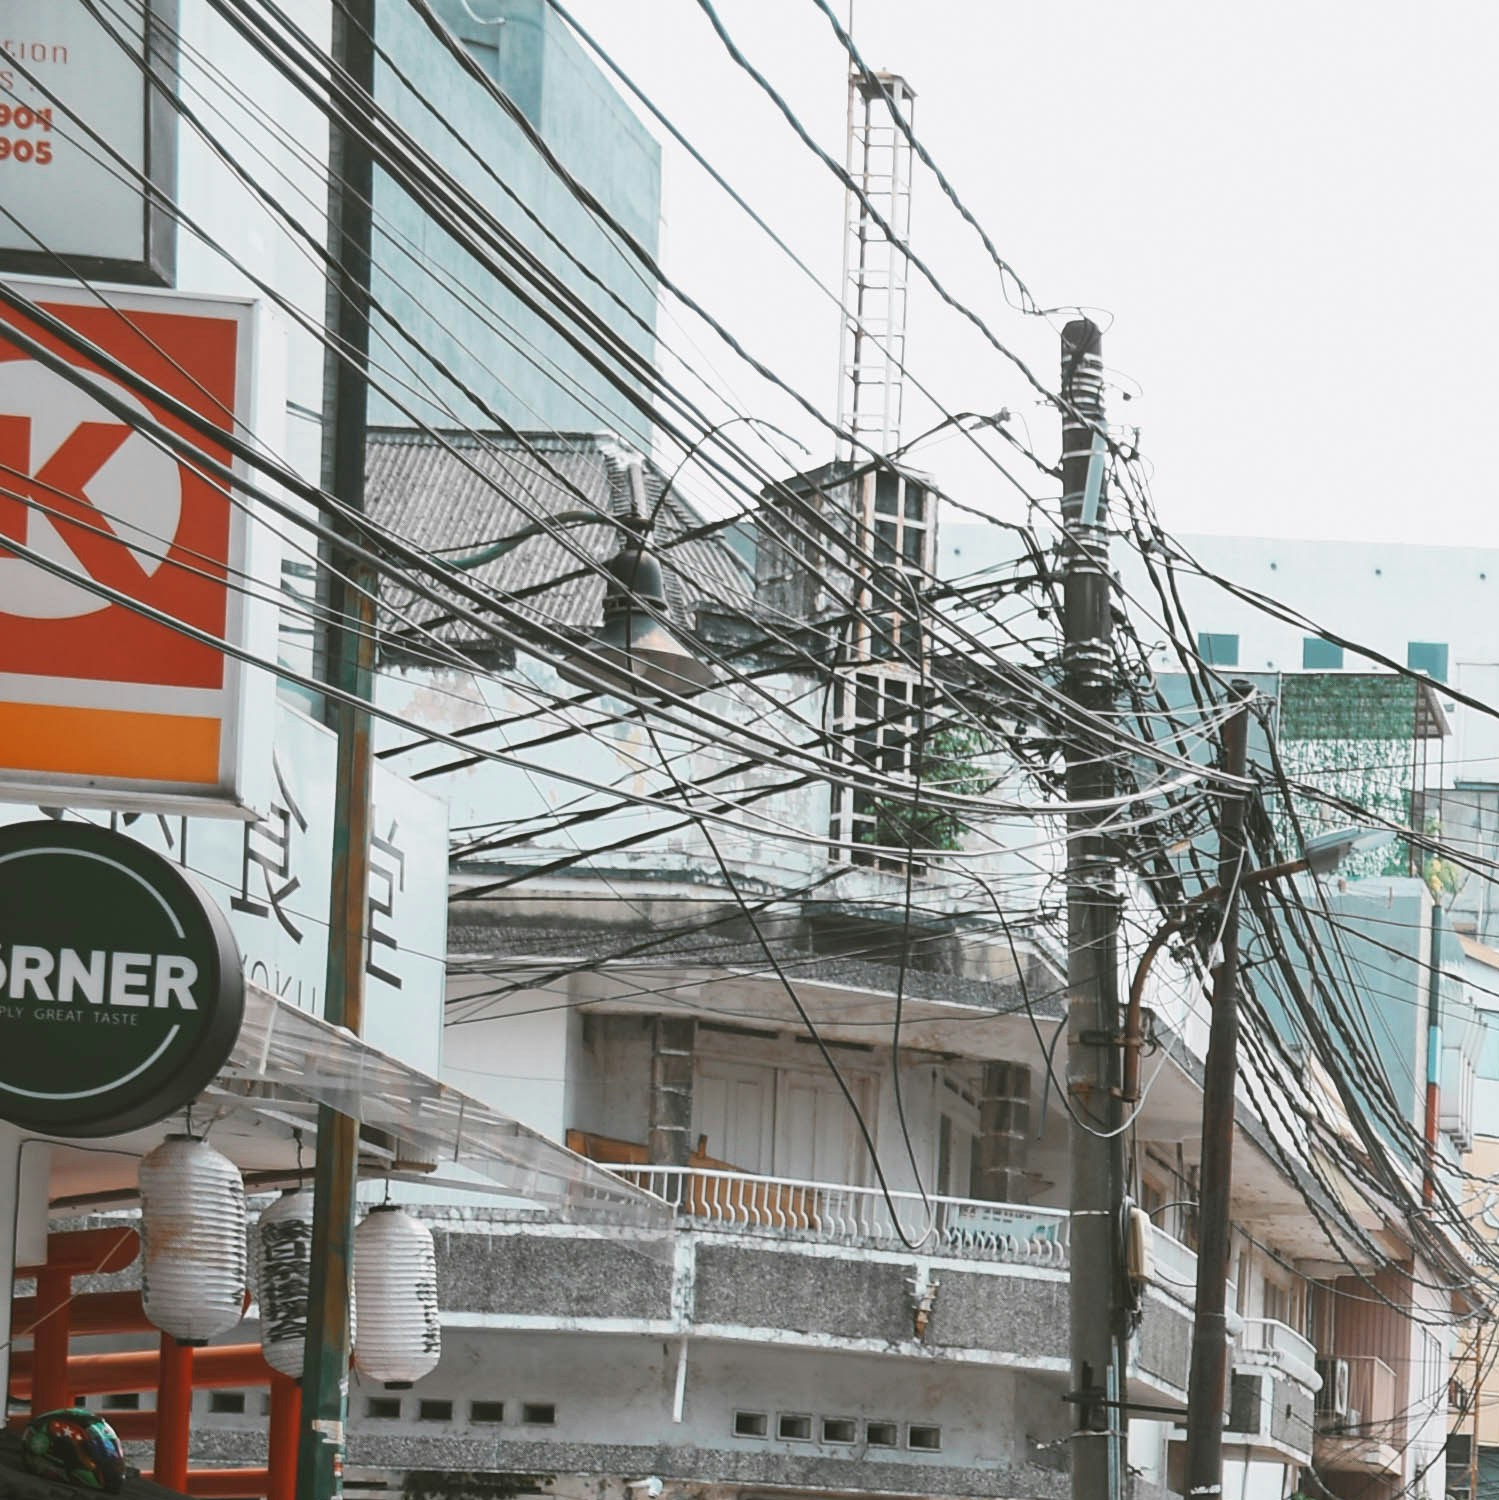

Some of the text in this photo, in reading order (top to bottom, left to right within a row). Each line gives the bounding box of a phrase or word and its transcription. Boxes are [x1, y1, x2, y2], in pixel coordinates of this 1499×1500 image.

[0, 944, 199, 1010] RNER
[34, 1007, 84, 1023] GREAT
[94, 1011, 139, 1026] TASTE
